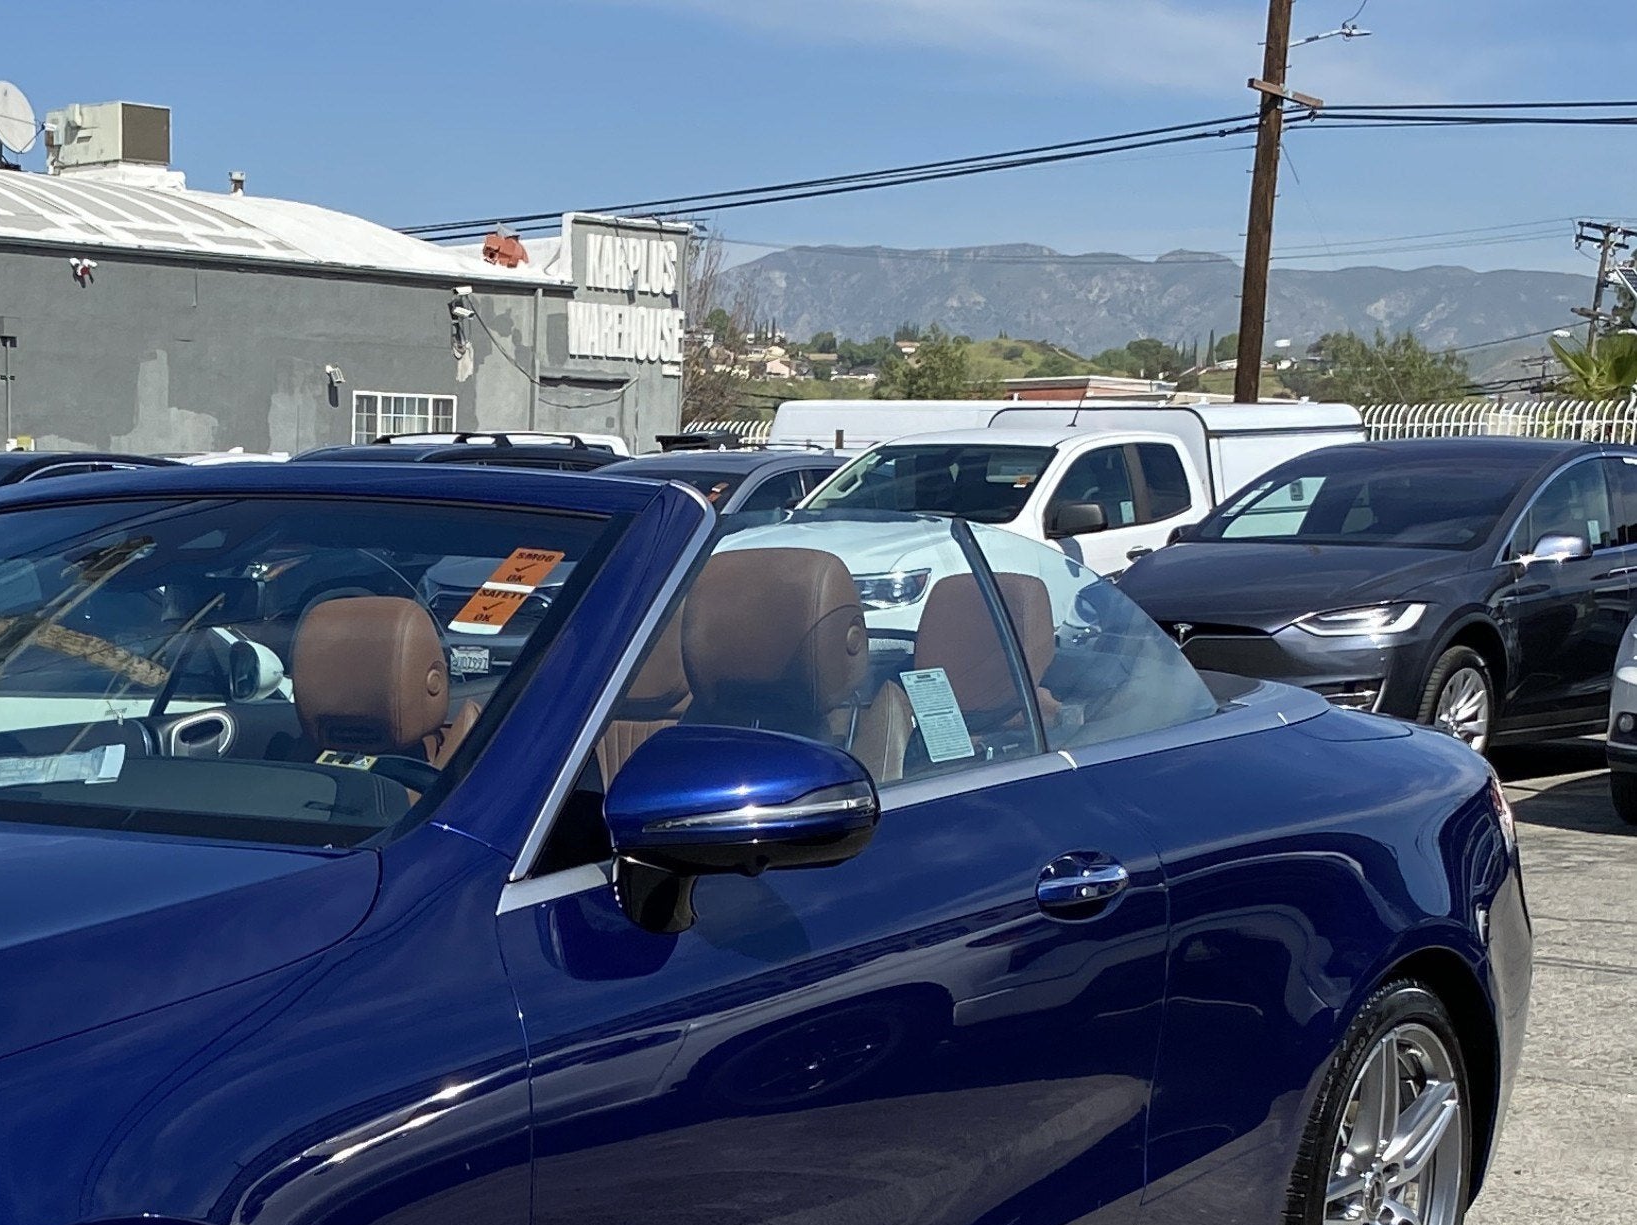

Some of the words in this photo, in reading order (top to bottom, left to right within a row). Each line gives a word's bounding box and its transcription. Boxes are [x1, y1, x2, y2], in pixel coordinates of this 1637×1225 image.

[585, 233, 678, 295] KARPLUS
[567, 301, 685, 364] WAREHOUSE
[515, 552, 556, 562] SMOG
[505, 574, 526, 583] OK
[477, 589, 528, 600] SAFETY
[472, 614, 494, 622] OK
